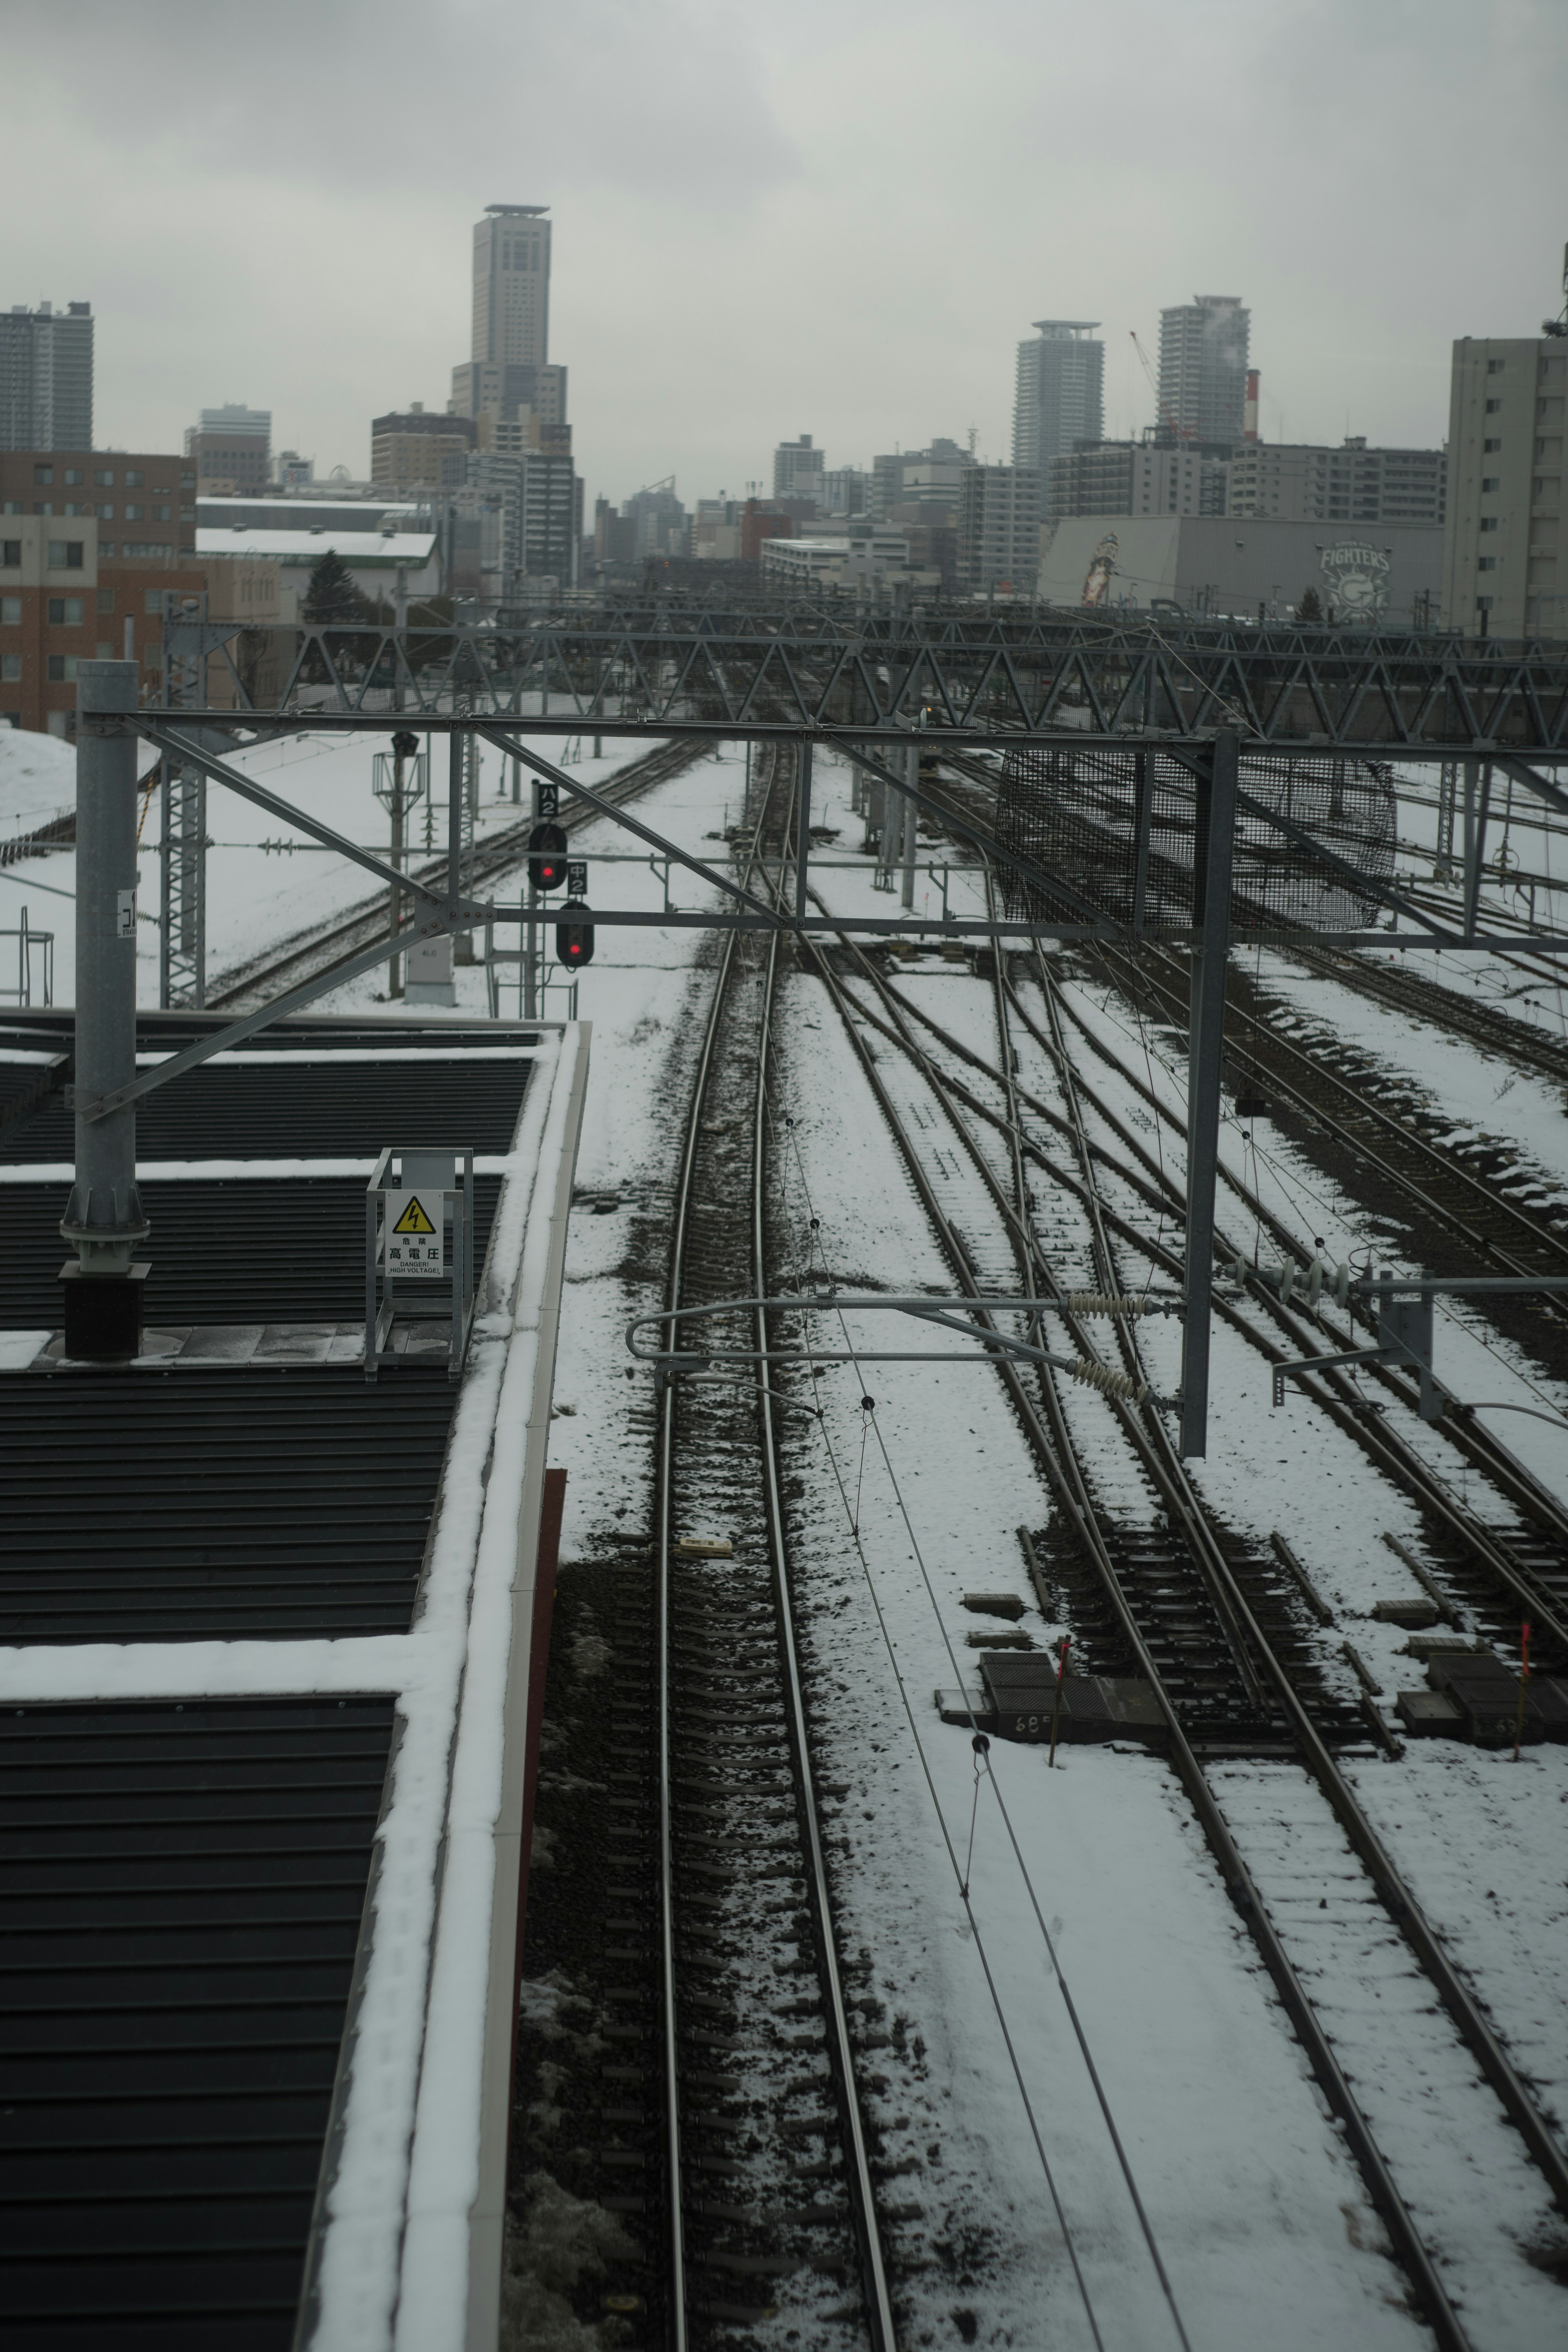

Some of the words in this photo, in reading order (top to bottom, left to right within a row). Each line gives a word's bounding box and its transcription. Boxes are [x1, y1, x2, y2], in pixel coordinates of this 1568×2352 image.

[1320, 548, 1390, 571] FIGHTERS
[390, 1248, 439, 1259] 高電圧
